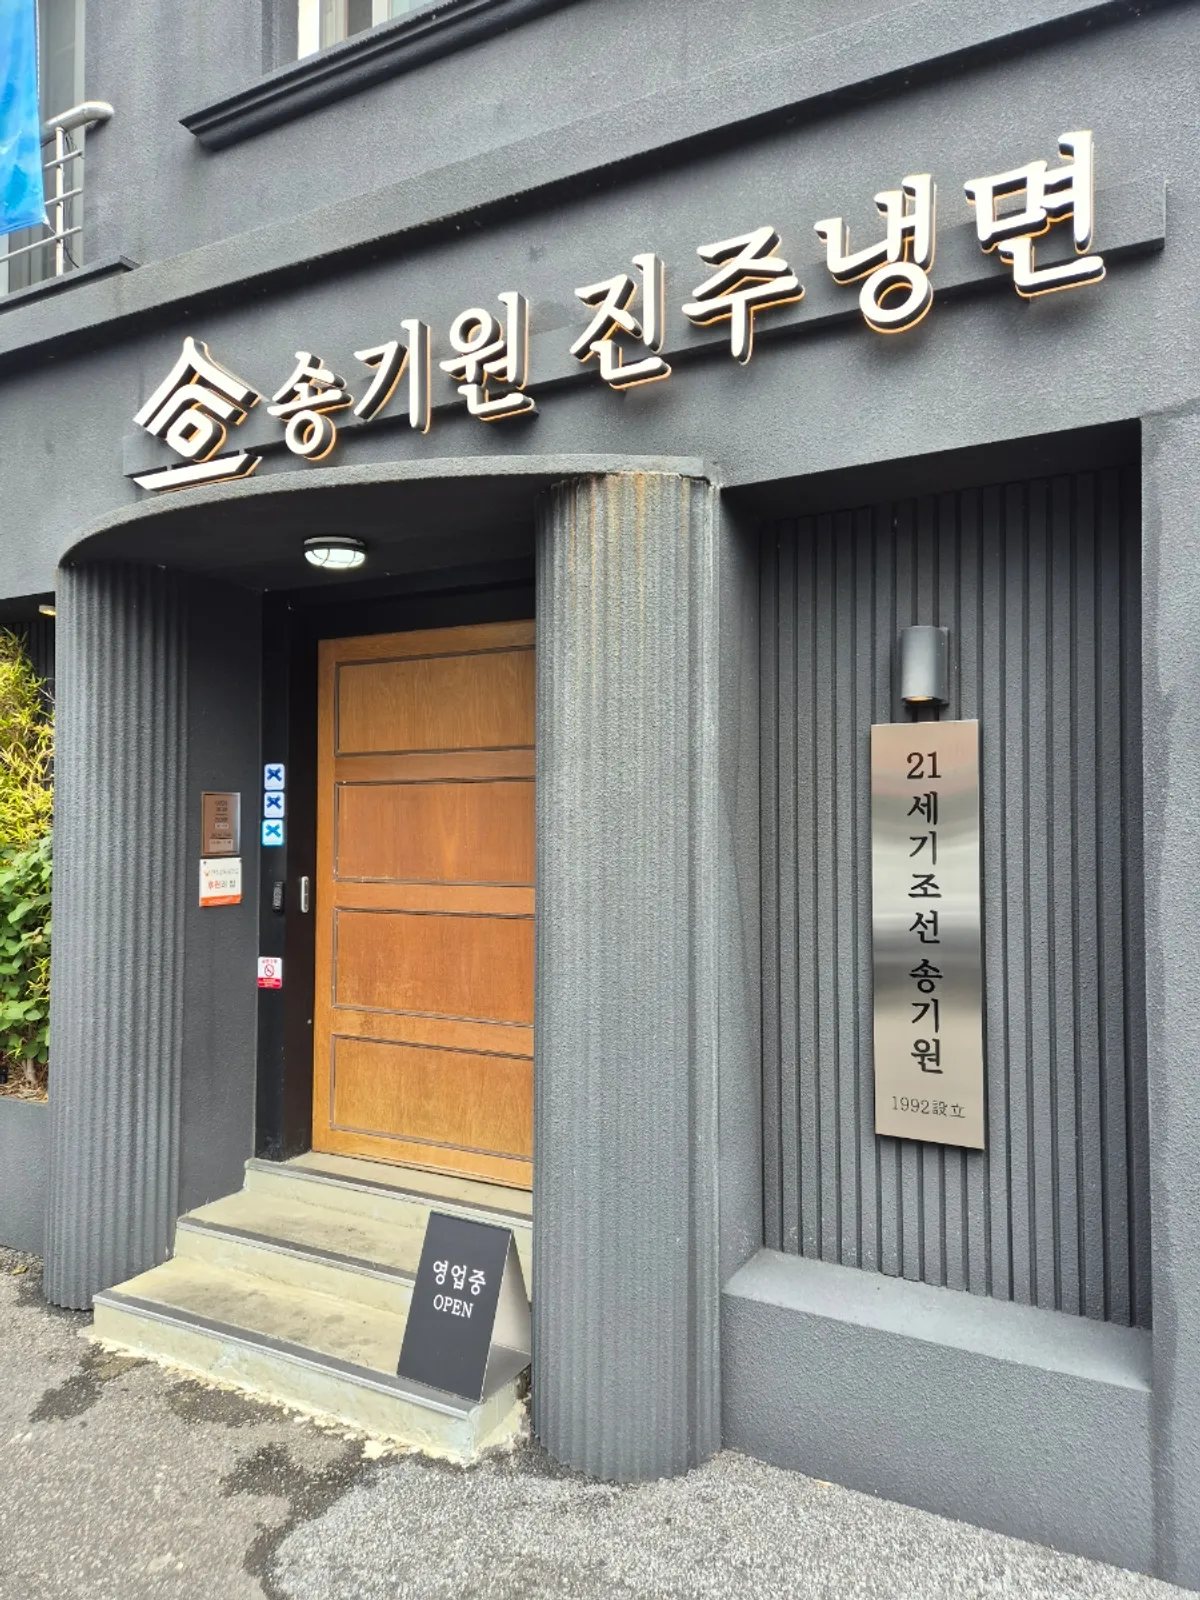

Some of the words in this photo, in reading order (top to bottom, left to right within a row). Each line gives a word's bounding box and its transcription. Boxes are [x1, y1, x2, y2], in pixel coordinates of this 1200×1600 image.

[267, 291, 535, 459] 송기원
[569, 130, 1106, 390] 진주냉면
[432, 1259, 487, 1296] 영업중
[433, 1293, 475, 1319] OPEN
